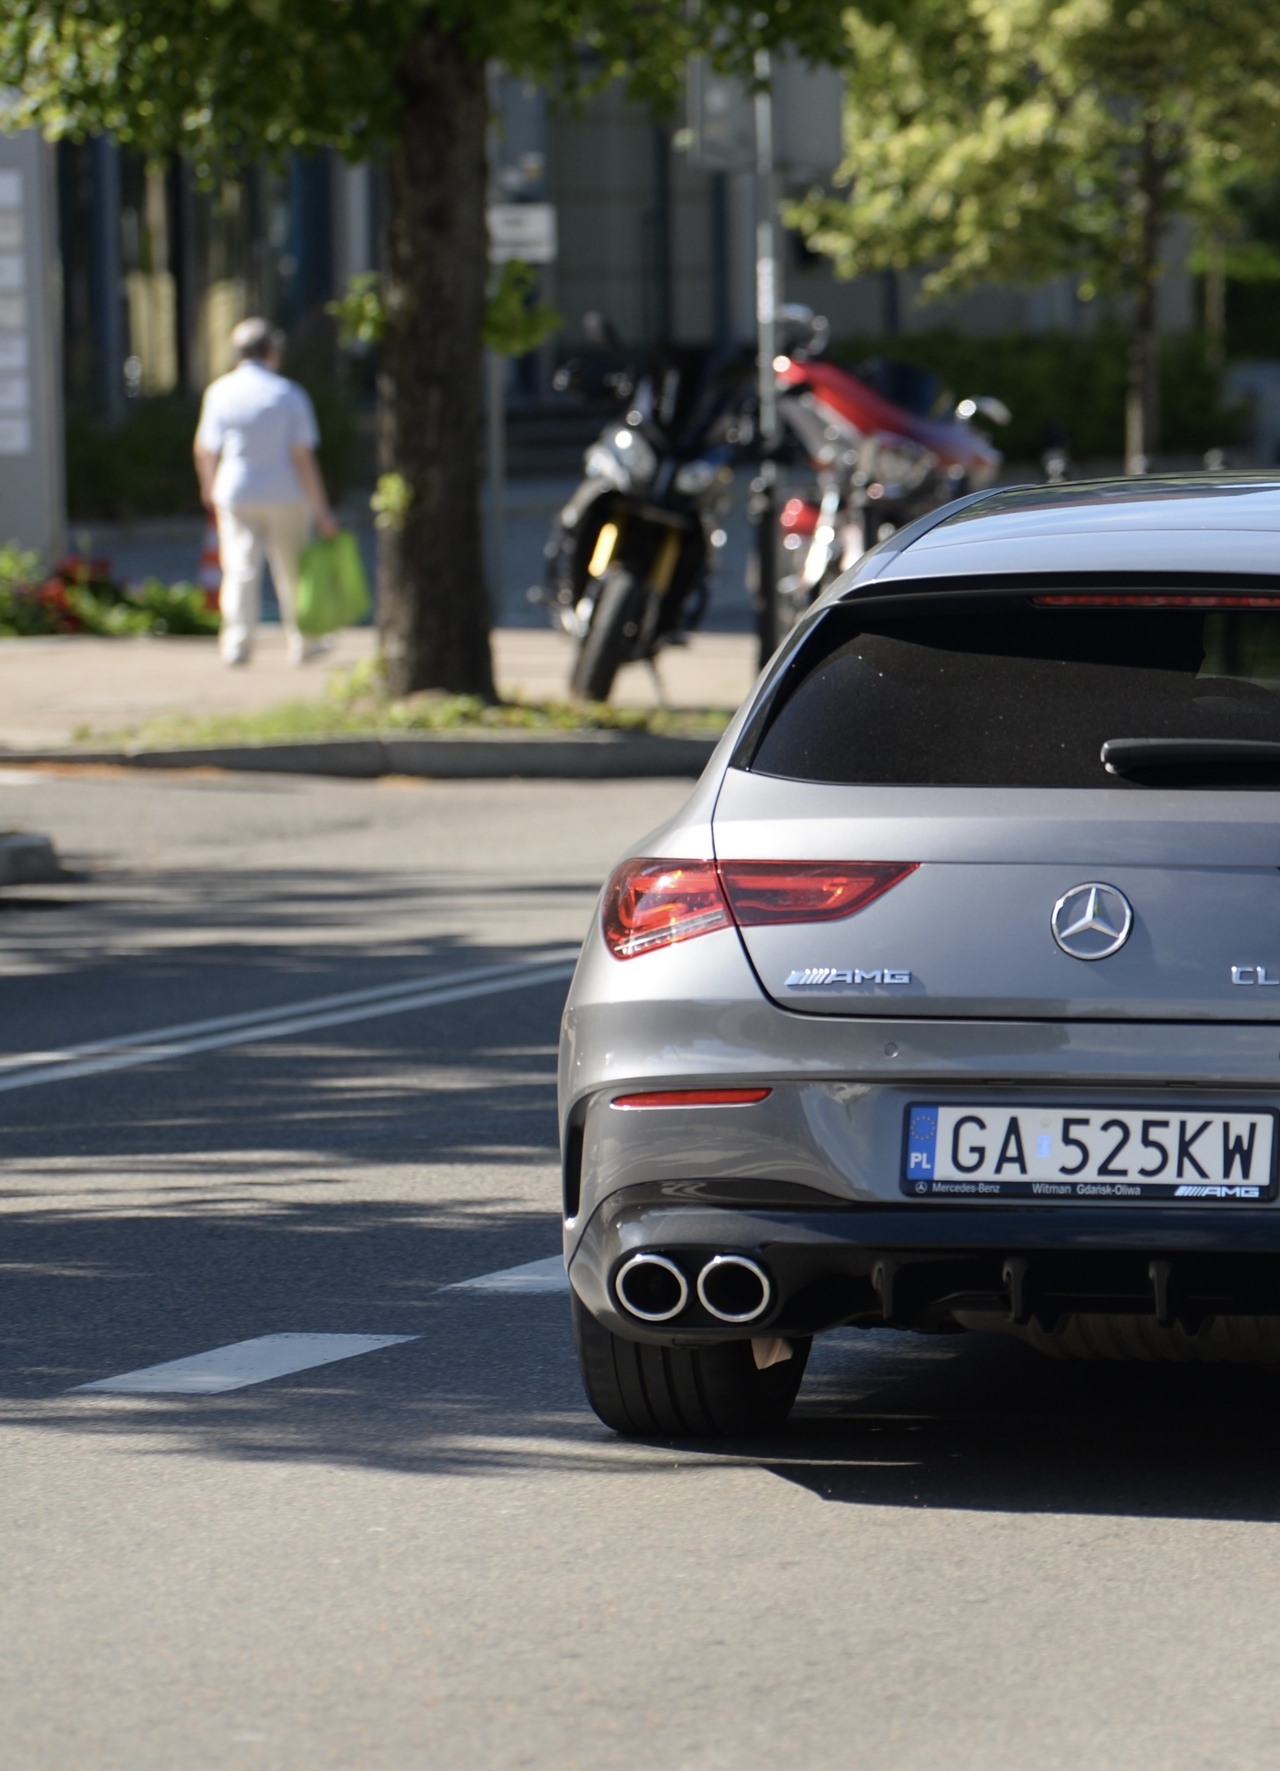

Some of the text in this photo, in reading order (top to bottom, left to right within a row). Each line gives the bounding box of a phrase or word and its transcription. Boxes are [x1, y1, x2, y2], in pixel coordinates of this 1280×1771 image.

[824, 968, 911, 985] AMG
[951, 1115, 1257, 1181] GA 525KW
[909, 1152, 932, 1170] PL
[931, 1182, 1001, 1194] Mercedes-Benz
[1031, 1183, 1072, 1195] Witman
[1200, 1186, 1260, 1198] AMG
